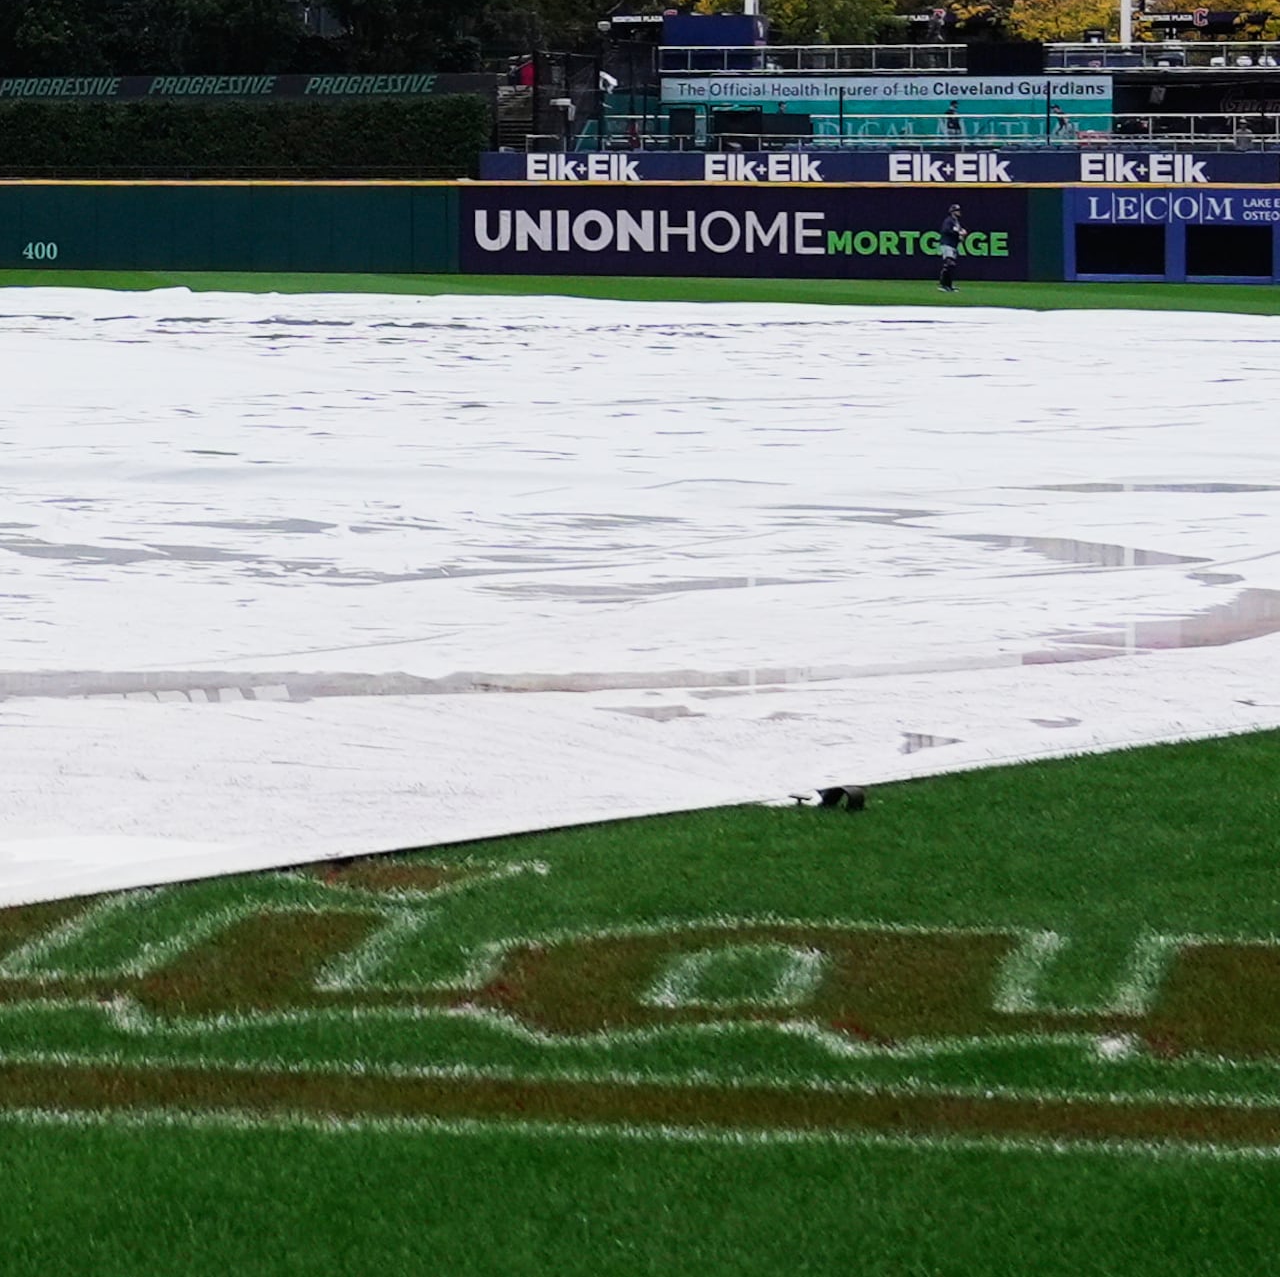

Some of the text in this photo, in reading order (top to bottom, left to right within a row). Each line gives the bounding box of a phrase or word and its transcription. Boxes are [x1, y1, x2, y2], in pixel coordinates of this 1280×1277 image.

[148, 76, 277, 95] PROGRESSIVE
[303, 75, 438, 95] PROGRESSIVE
[677, 81, 1106, 96] The Official Health Insurer of the Cleveland Guardians
[525, 153, 640, 181] Elk+Elk
[704, 153, 822, 182] Elk+Elk
[889, 153, 1013, 183] Elk+Elk
[1080, 153, 1209, 183] Elk+Elk
[1242, 197, 1272, 208] LAKE
[22, 241, 59, 261] 400
[827, 230, 1010, 257] MORTGGE
